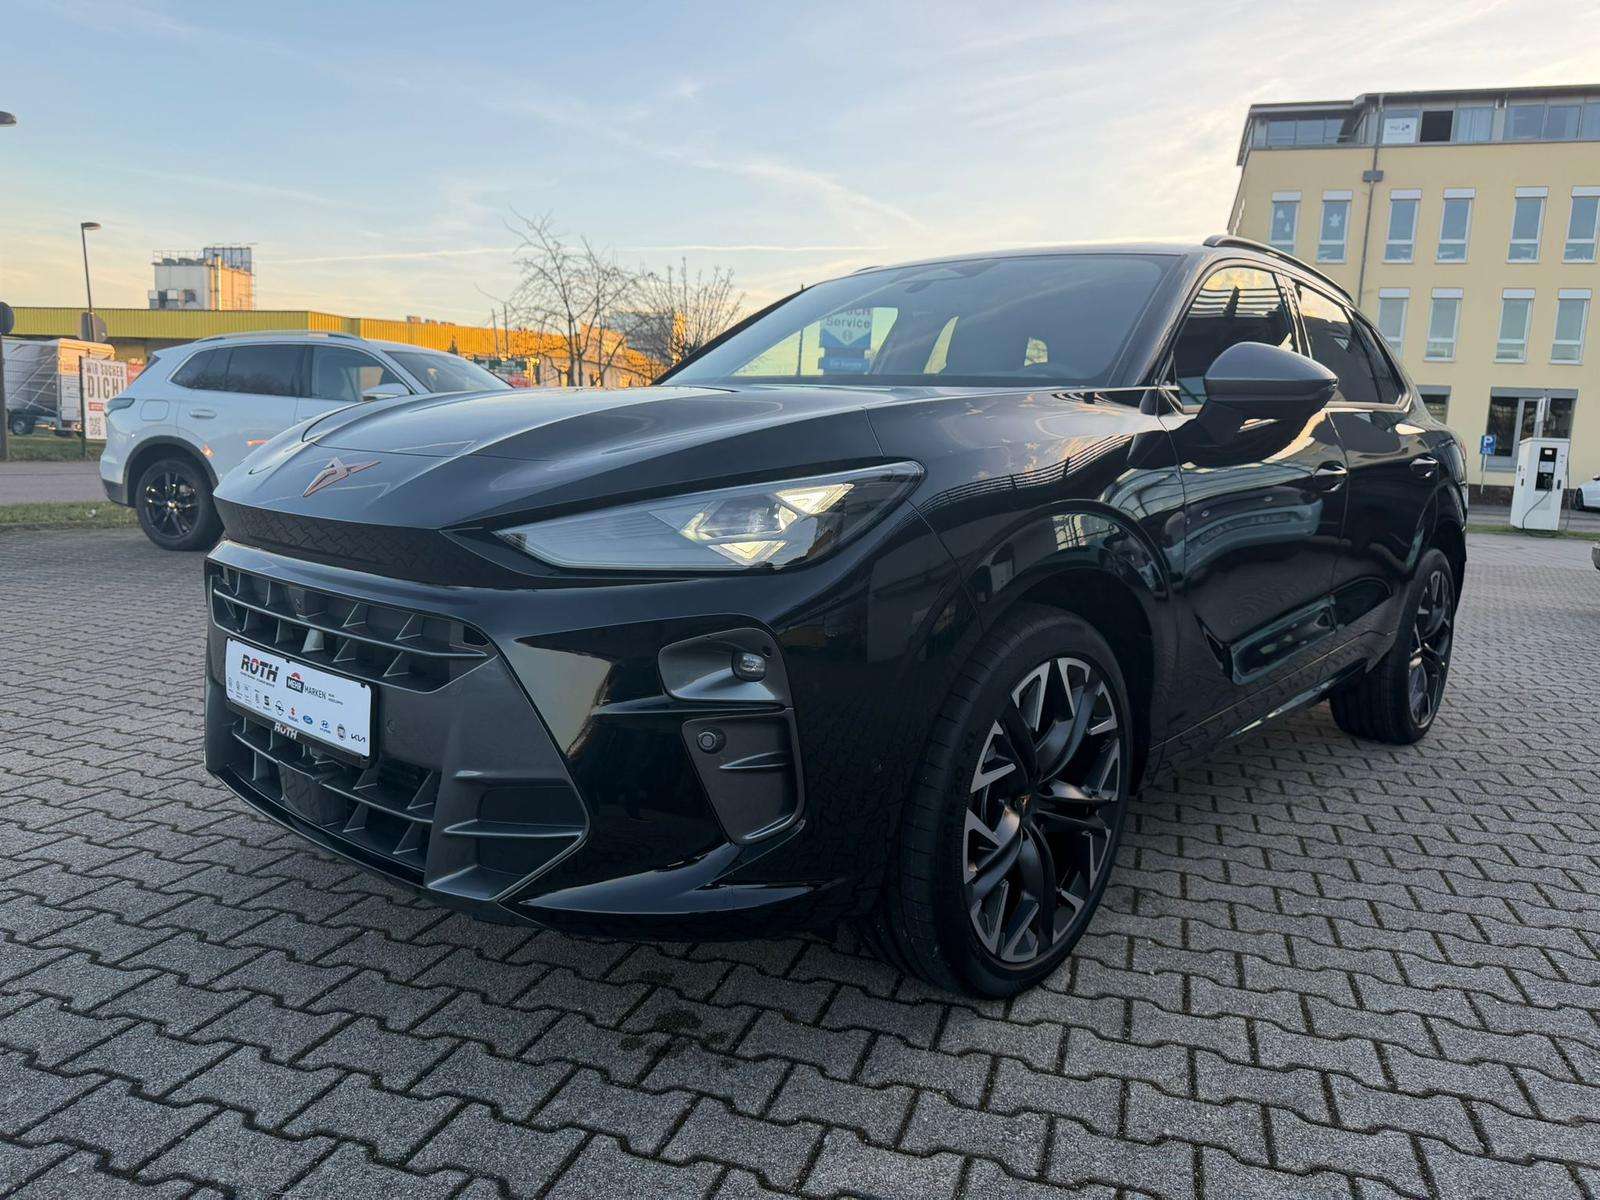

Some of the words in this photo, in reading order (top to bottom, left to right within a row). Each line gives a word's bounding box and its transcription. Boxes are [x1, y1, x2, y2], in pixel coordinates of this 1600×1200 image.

[826, 318, 870, 329] Service
[1483, 435, 1493, 447] P
[241, 654, 279, 683] ROTH
[304, 685, 327, 700] MARKEN
[274, 722, 297, 740] ROTH
